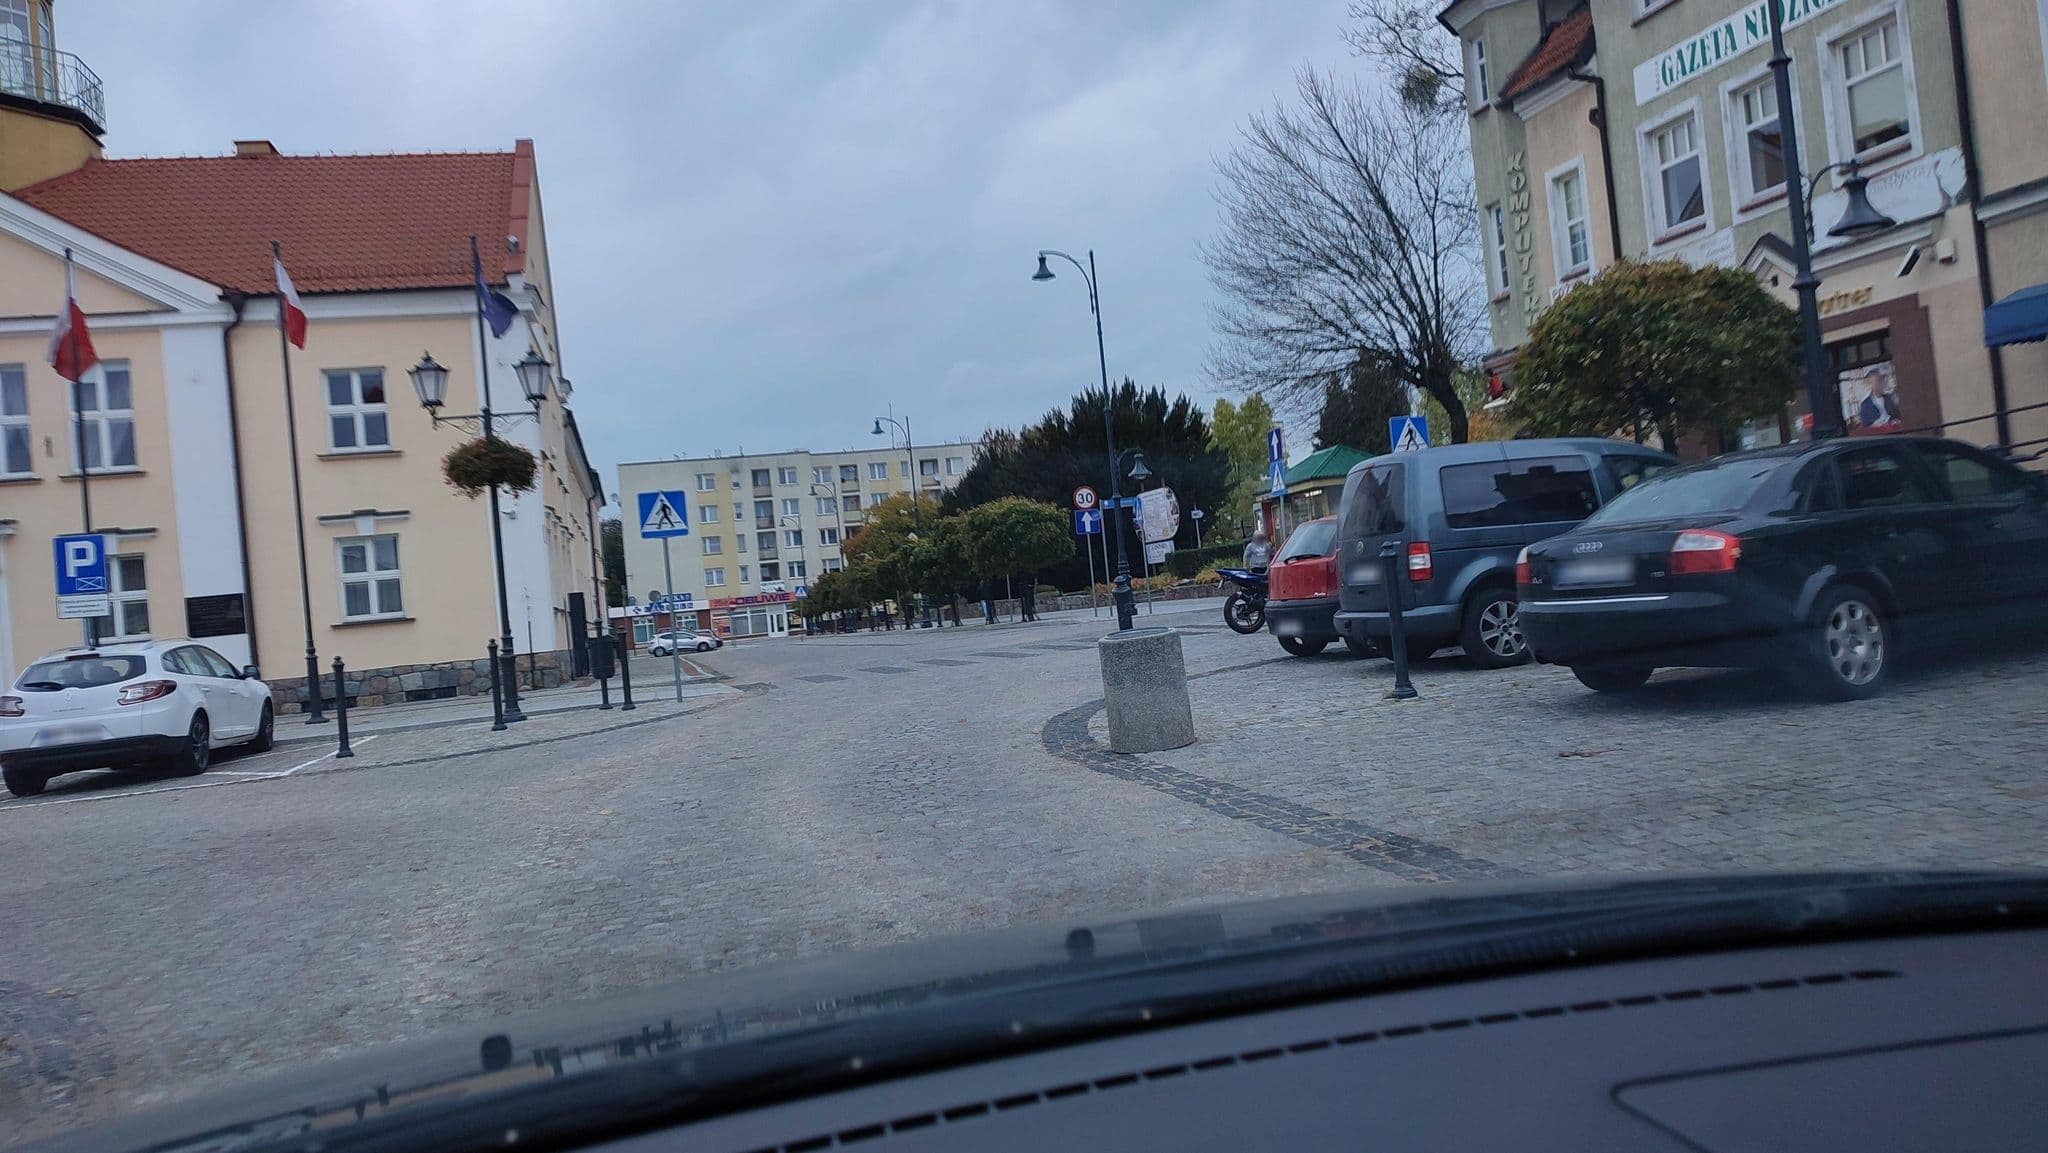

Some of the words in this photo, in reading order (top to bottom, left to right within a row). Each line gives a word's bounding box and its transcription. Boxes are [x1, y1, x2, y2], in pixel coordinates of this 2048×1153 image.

[1660, 22, 1738, 89] GAZETA
[1077, 492, 1093, 504] 30
[64, 540, 97, 578] P
[735, 592, 791, 606] OBUWIE
